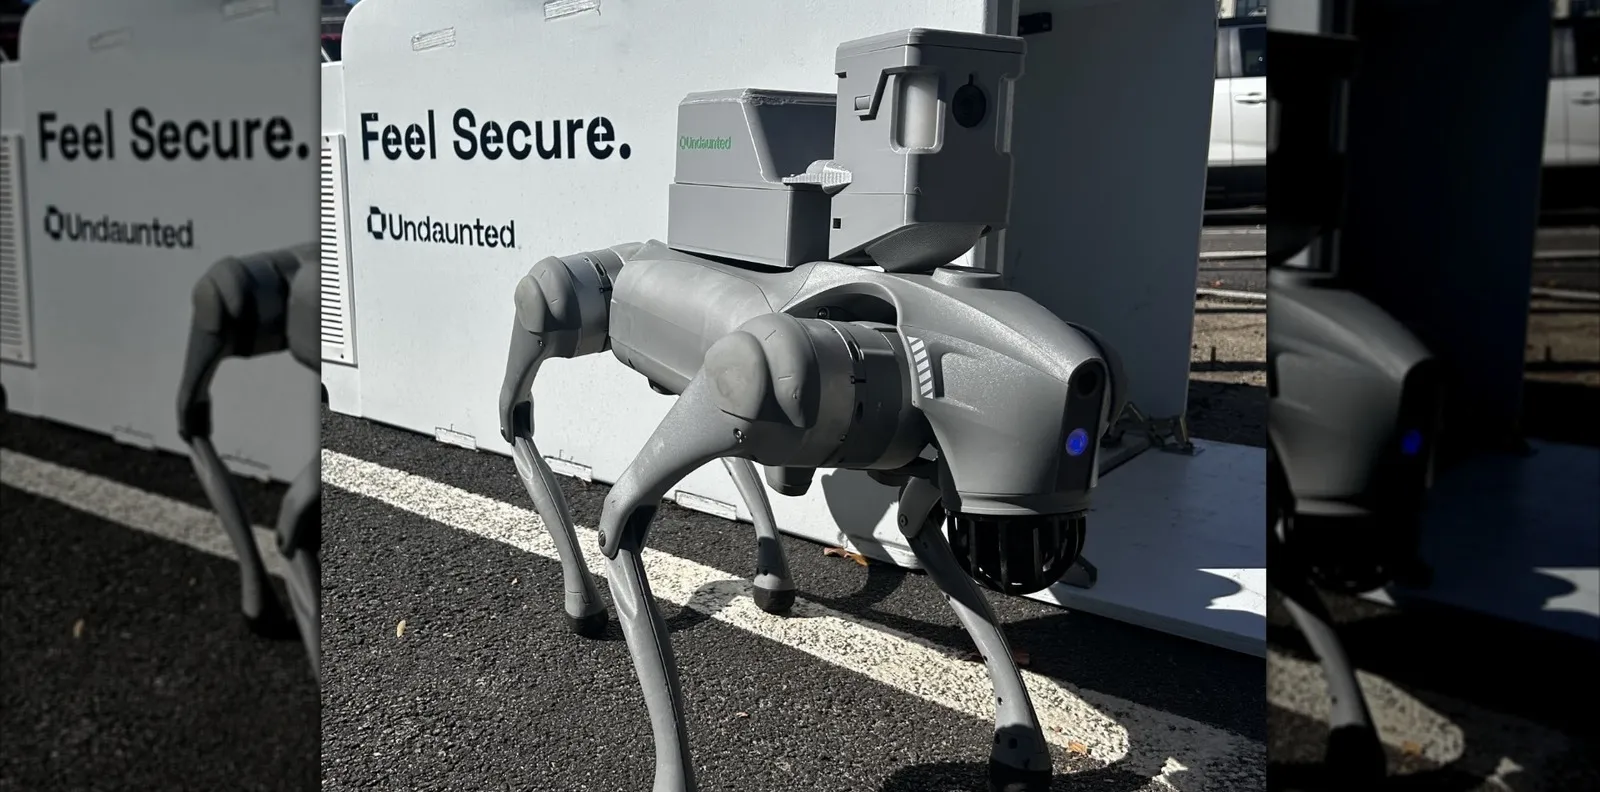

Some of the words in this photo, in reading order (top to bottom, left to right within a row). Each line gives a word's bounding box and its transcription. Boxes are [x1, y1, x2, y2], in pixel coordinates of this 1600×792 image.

[37, 108, 115, 163] Feel
[129, 107, 310, 162] Secure.
[360, 109, 437, 161] Feel
[452, 107, 632, 161] Secure.
[686, 136, 732, 150] Undaunted
[65, 212, 194, 249] Undaunted
[388, 213, 516, 249] Undaunted
